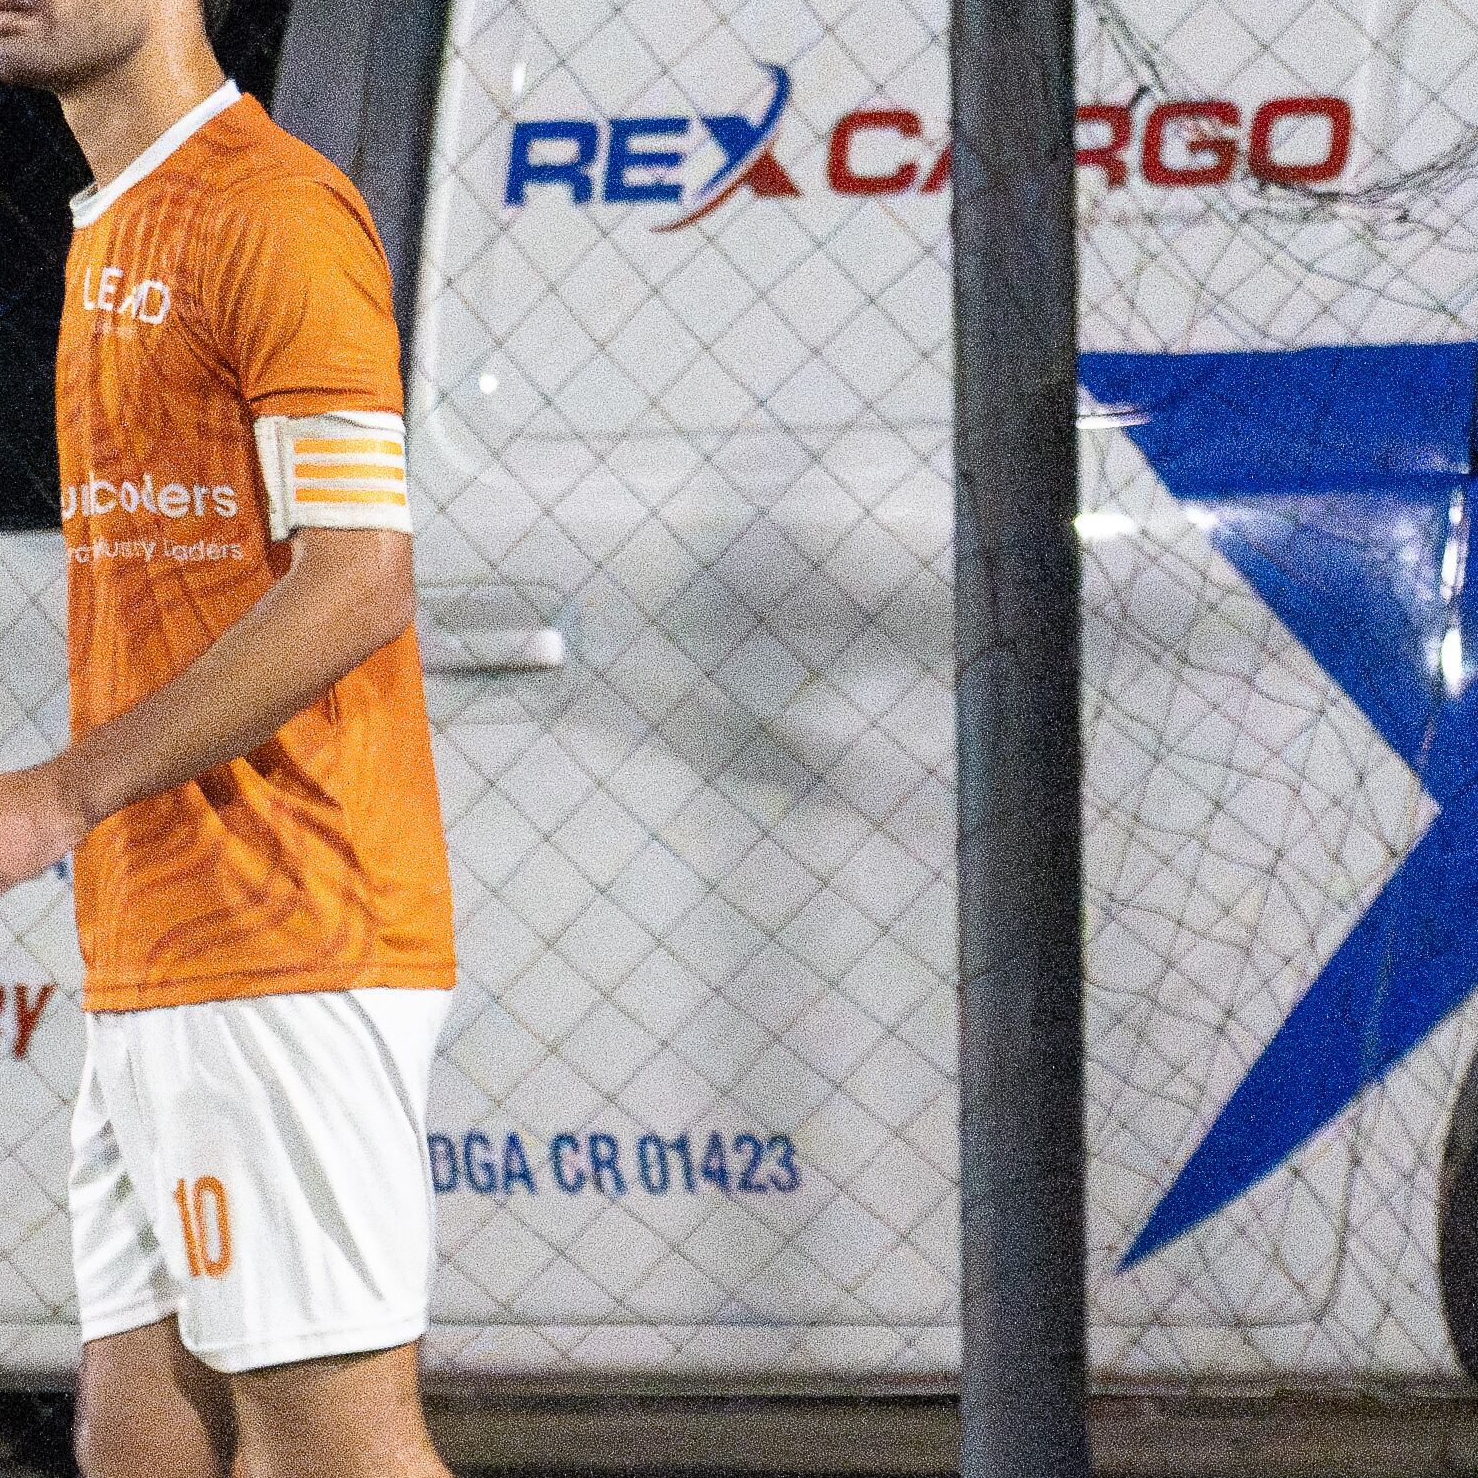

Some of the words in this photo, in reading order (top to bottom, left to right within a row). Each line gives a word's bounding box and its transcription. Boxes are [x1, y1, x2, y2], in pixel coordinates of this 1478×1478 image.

[503, 64, 802, 232] REX
[826, 96, 1352, 197] CRGO
[549, 1132, 628, 1197] CR
[637, 1131, 801, 1195] 01423
[172, 1174, 233, 1278] 10
